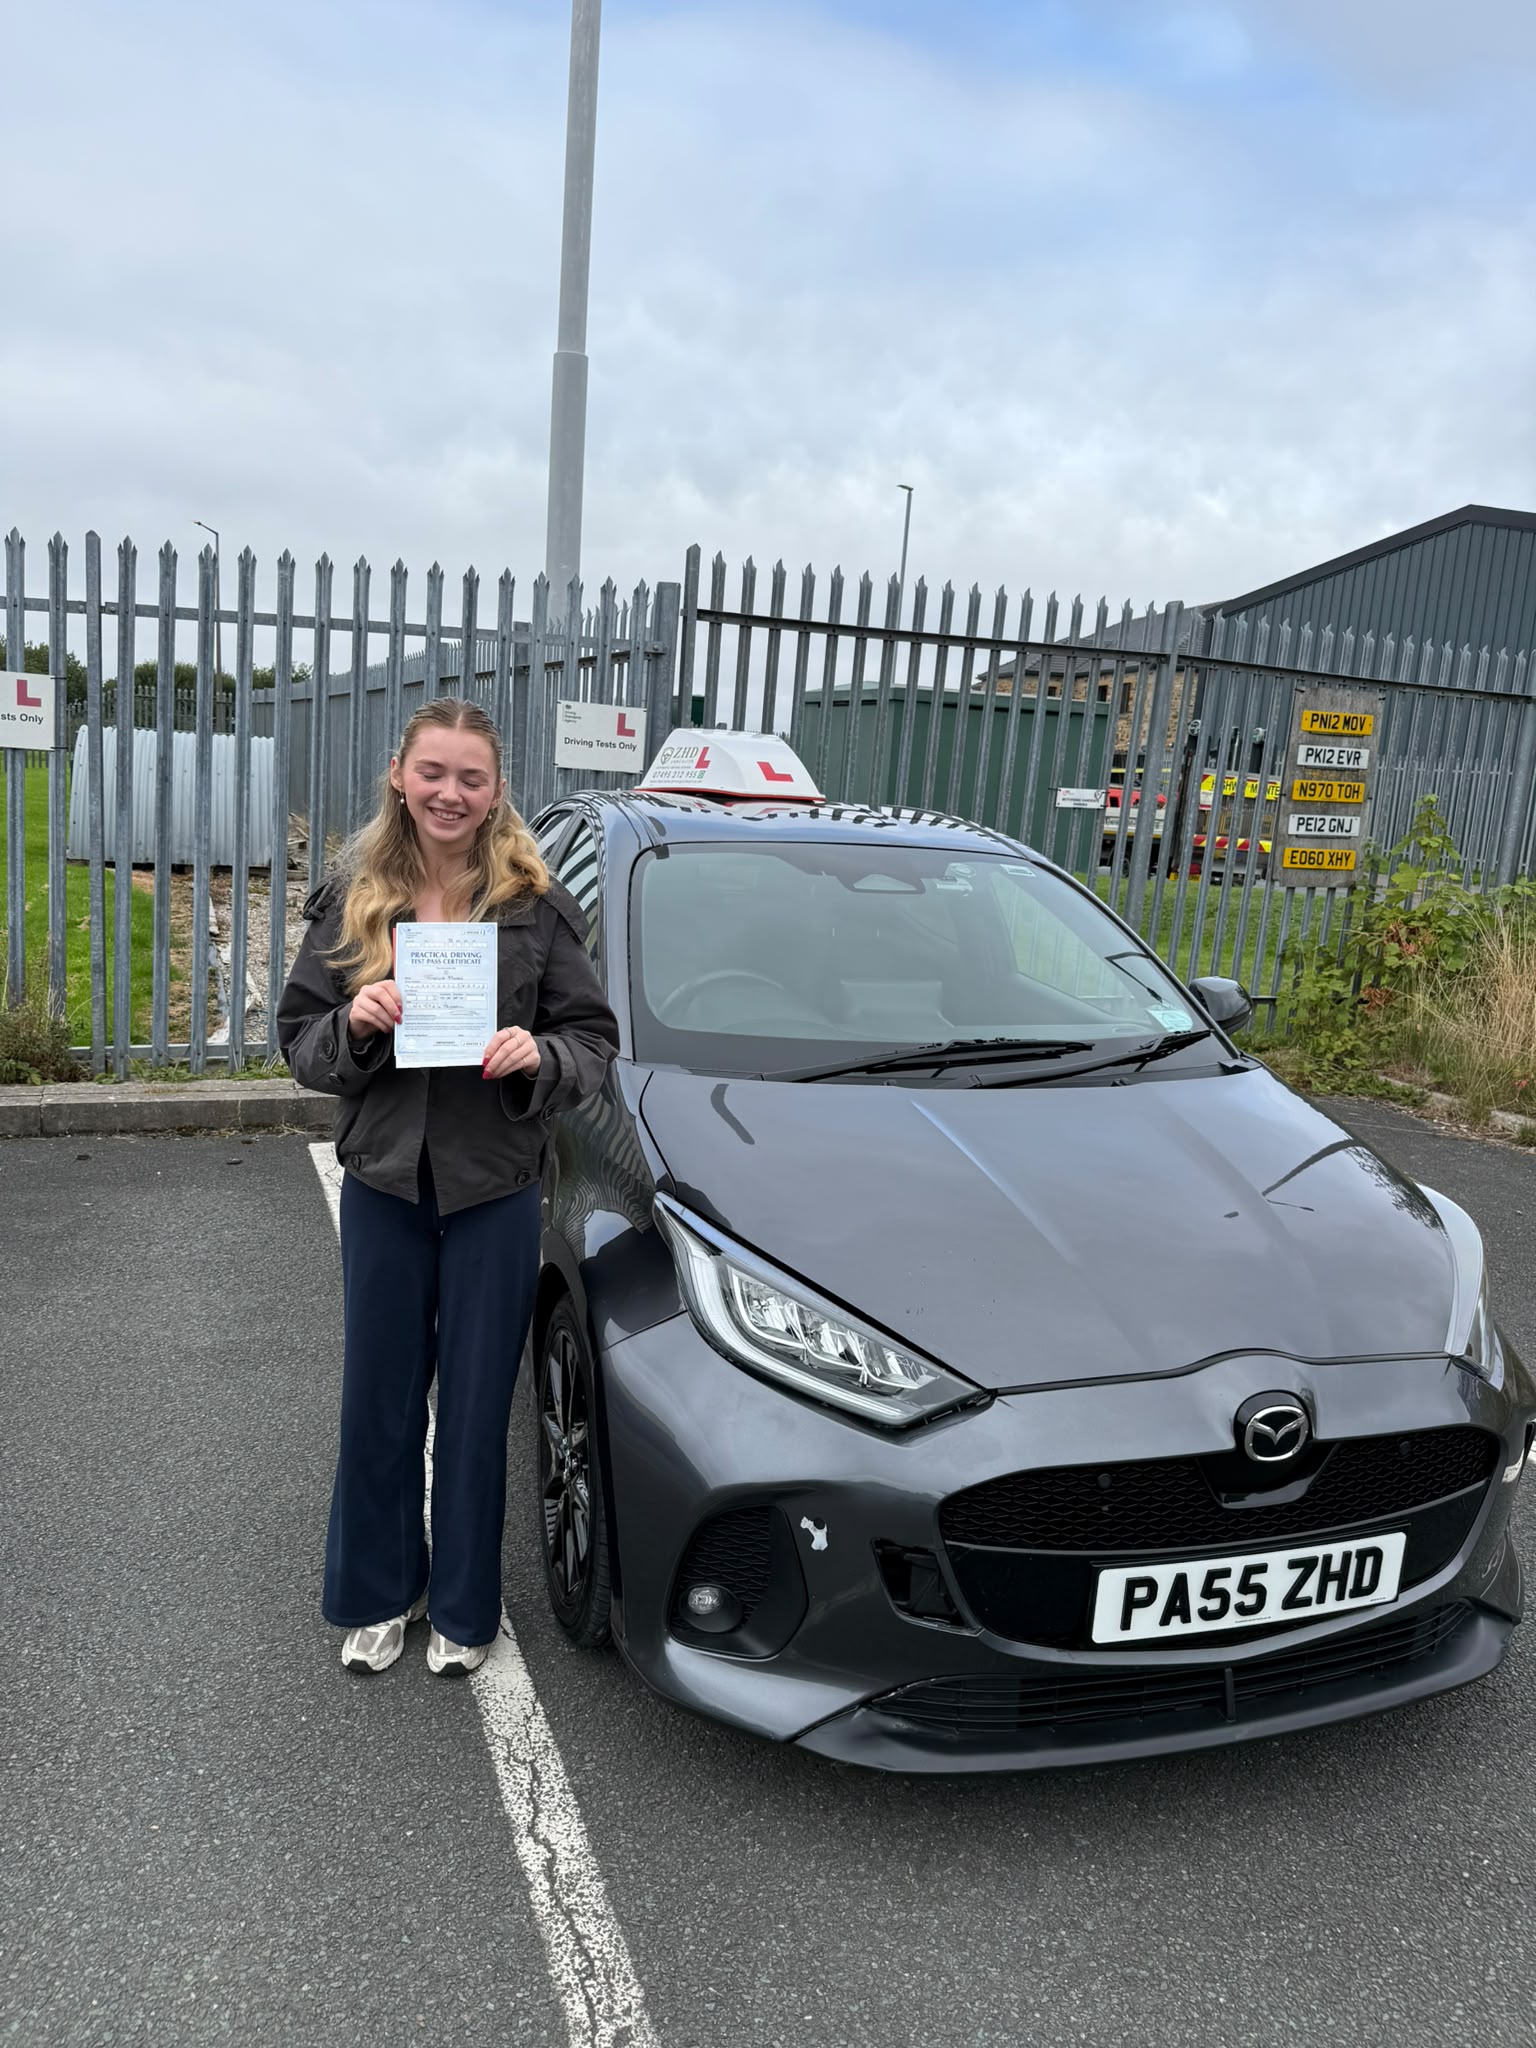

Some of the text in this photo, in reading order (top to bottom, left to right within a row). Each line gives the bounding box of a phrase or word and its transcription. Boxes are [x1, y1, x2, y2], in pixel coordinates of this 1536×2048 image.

[17, 679, 41, 707] L
[0, 713, 43, 725] sts Only
[617, 712, 635, 737] L
[1310, 713, 1366, 732] PN12 MOV
[564, 737, 637, 752] Driving Tests Only
[673, 746, 699, 759] ZHD
[1305, 747, 1361, 766] PK12 EVR
[1298, 782, 1360, 799] N970 TOH
[1296, 817, 1353, 833] PE12 GNJ
[1290, 850, 1351, 867] EO60 XHY
[1119, 1545, 1384, 1631] PA55 ZHD
